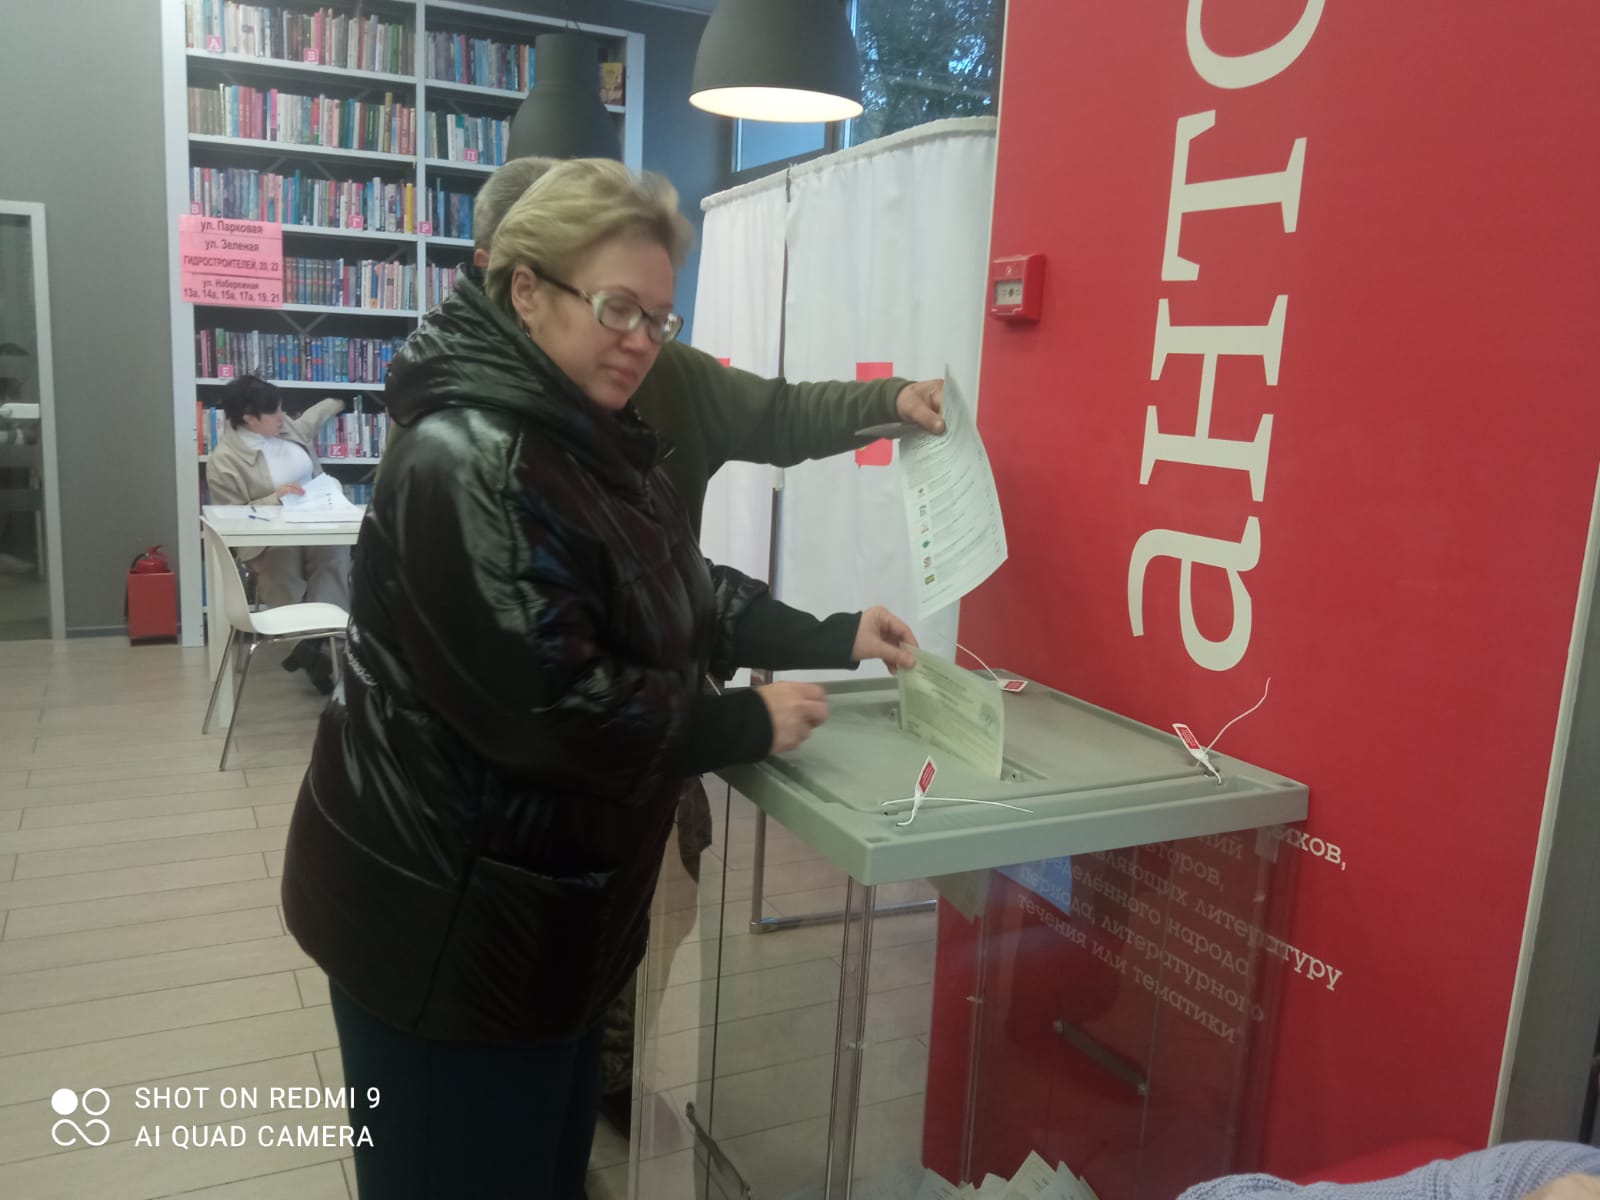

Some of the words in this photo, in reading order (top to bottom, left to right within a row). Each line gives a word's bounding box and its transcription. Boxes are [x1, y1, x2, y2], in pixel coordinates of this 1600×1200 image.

[200, 220, 215, 232] ул.
[217, 220, 264, 234] Парковая
[205, 240, 219, 251] ул.
[221, 239, 260, 252] Зеленая
[271, 262, 280, 272] 22
[270, 293, 280, 303] 21
[1144, 841, 1224, 892] второв,
[1017, 893, 1087, 948] течения
[1090, 940, 1128, 976] или
[1166, 916, 1249, 977] народа
